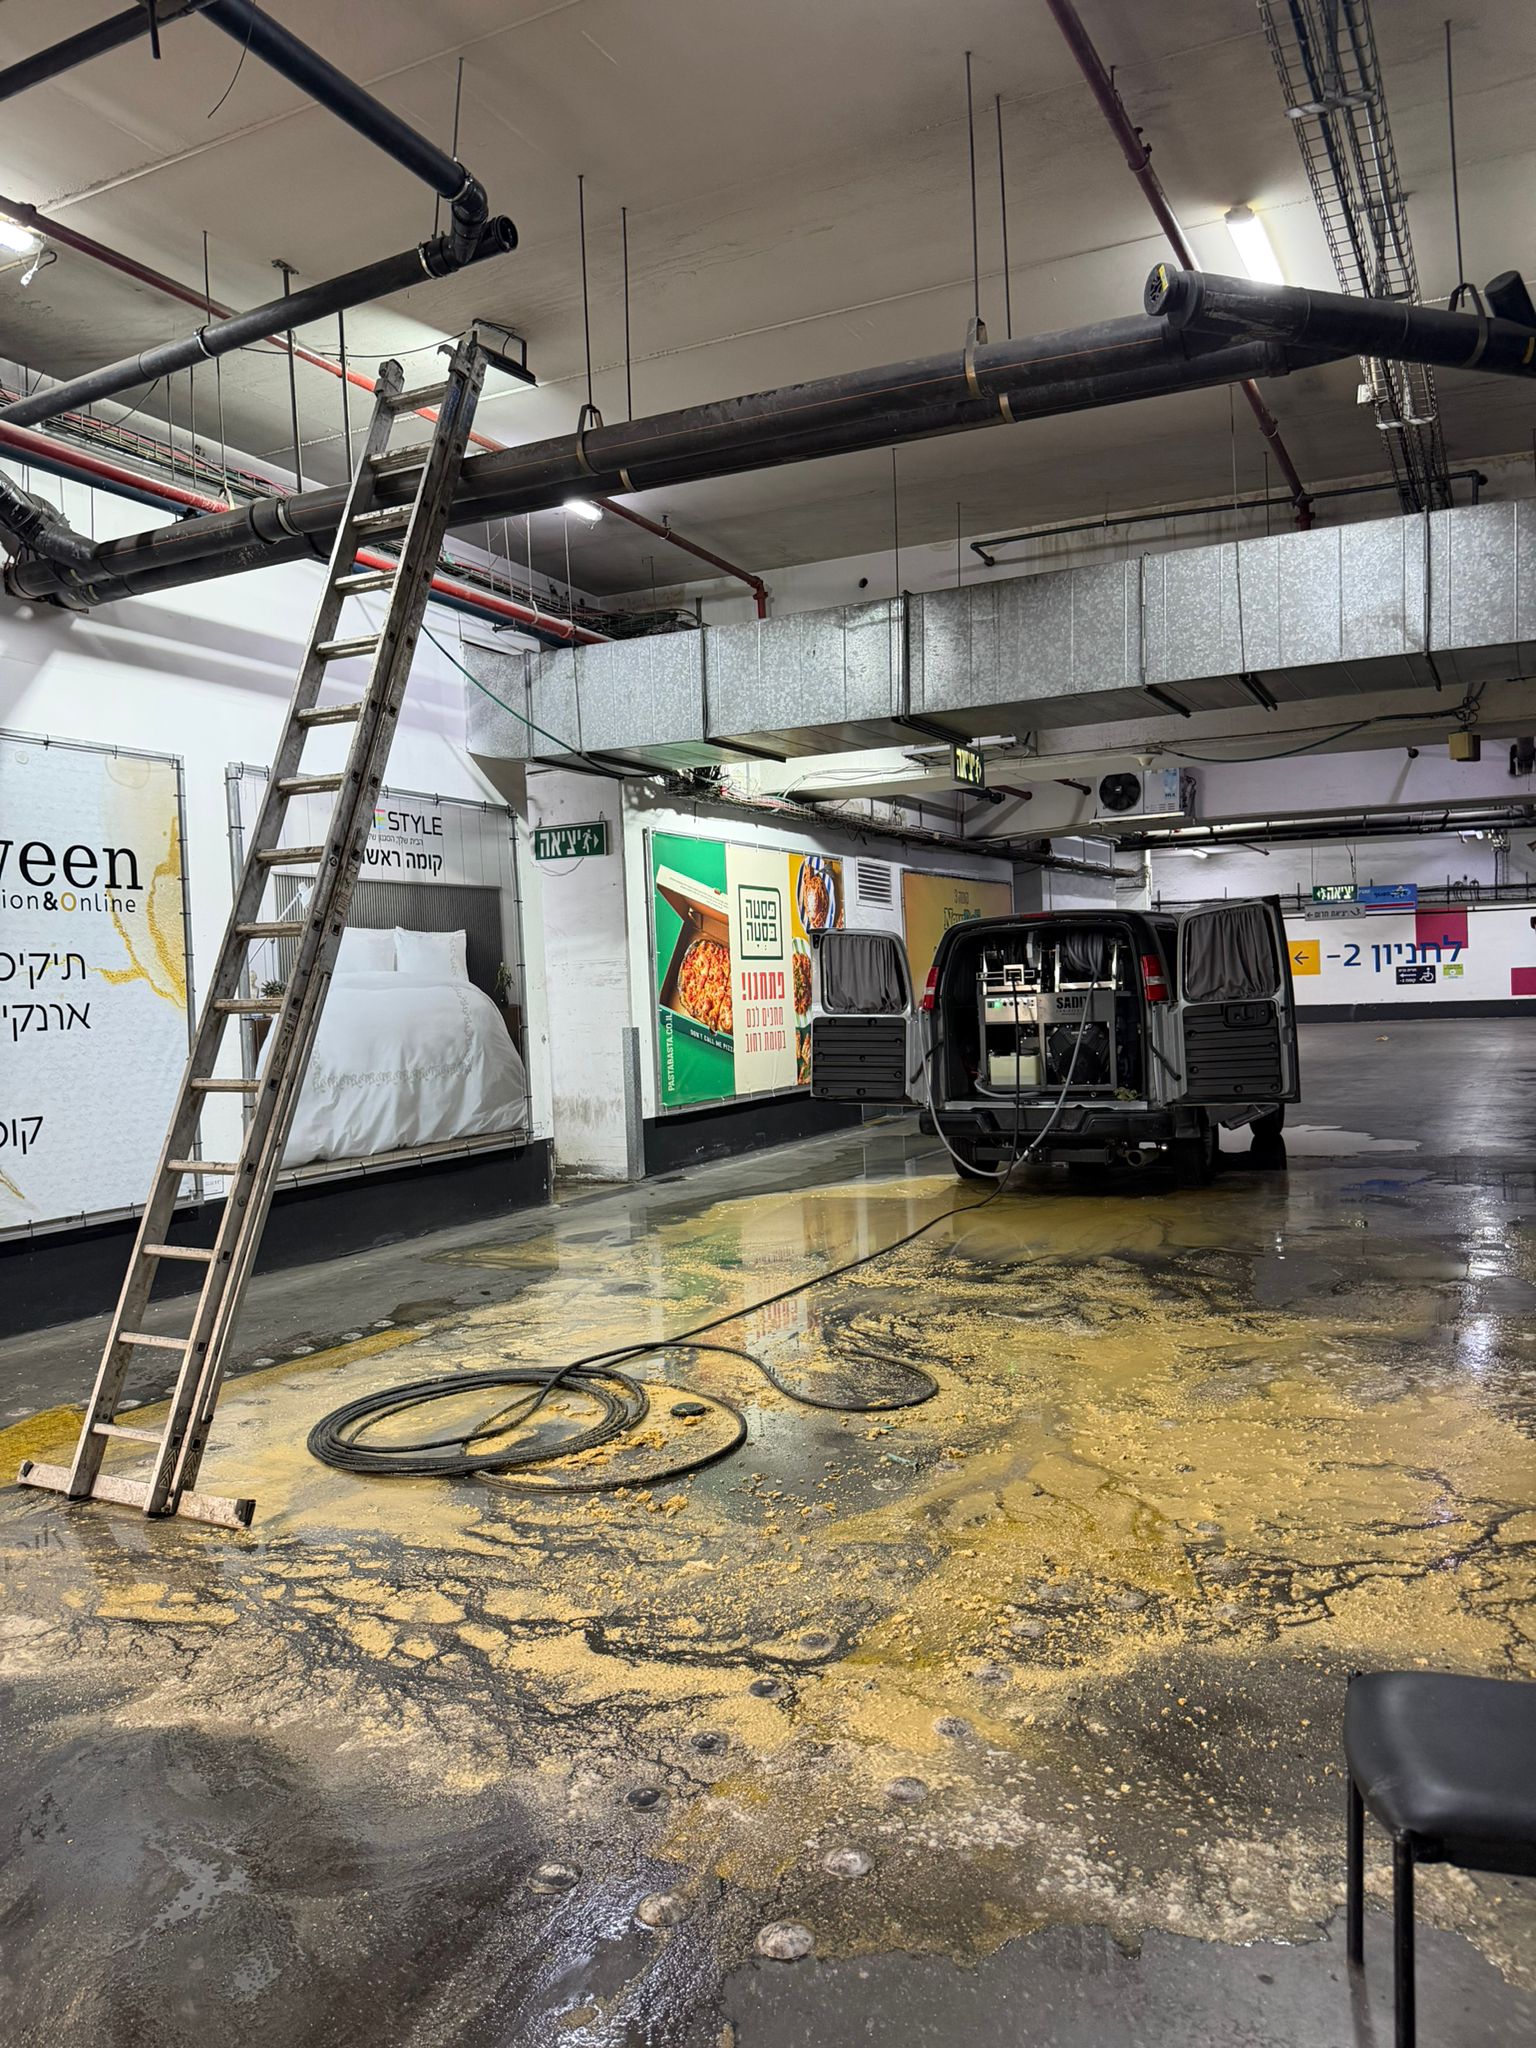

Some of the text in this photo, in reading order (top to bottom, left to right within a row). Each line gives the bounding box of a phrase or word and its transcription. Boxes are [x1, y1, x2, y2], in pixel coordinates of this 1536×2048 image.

[540, 829, 582, 858] יציאה
[406, 853, 443, 876] קומה
[1326, 886, 1354, 900] יציאה
[745, 899, 777, 920] פסטה
[746, 922, 777, 942] בסטה
[1371, 935, 1463, 973] לחניון
[741, 972, 785, 1001] פתחנו!
[665, 1011, 675, 1092] PASTABASTA.CO.IL
[722, 1043, 734, 1053] PIZZ
